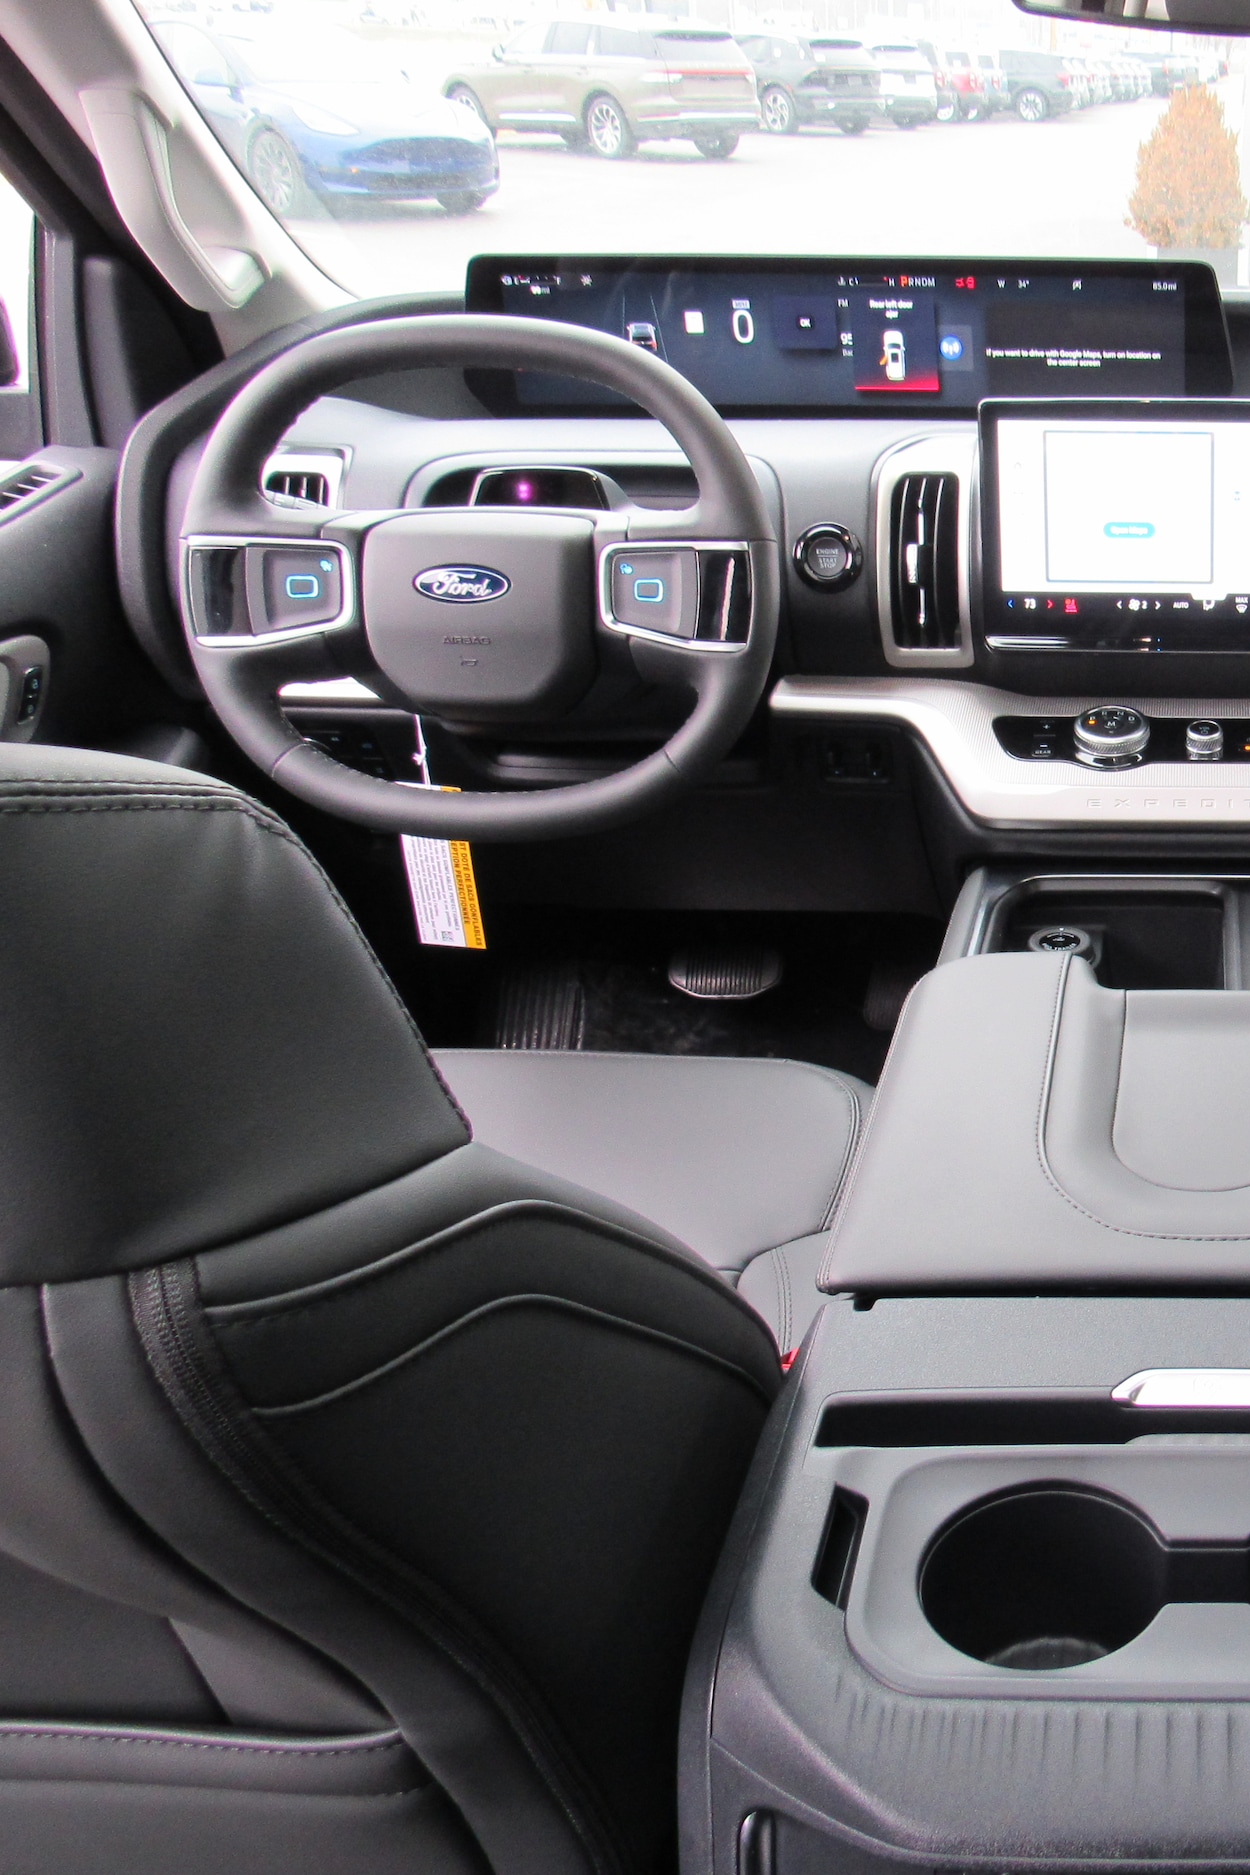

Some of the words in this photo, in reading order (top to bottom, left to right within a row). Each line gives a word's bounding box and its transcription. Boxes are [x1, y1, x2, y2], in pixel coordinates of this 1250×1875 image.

[997, 279, 1006, 289] W
[732, 308, 755, 344] 0
[799, 318, 812, 328] OK
[992, 350, 1004, 358] you
[1059, 349, 1082, 360] Google
[419, 571, 492, 596] Ford
[1024, 598, 1037, 609] 73
[1141, 601, 1148, 609] 2
[1173, 600, 1189, 609] AUTO
[443, 636, 491, 645] AIRBAG
[452, 841, 460, 868] EPTION
[464, 873, 471, 881] DE
[466, 884, 474, 901] SACS
